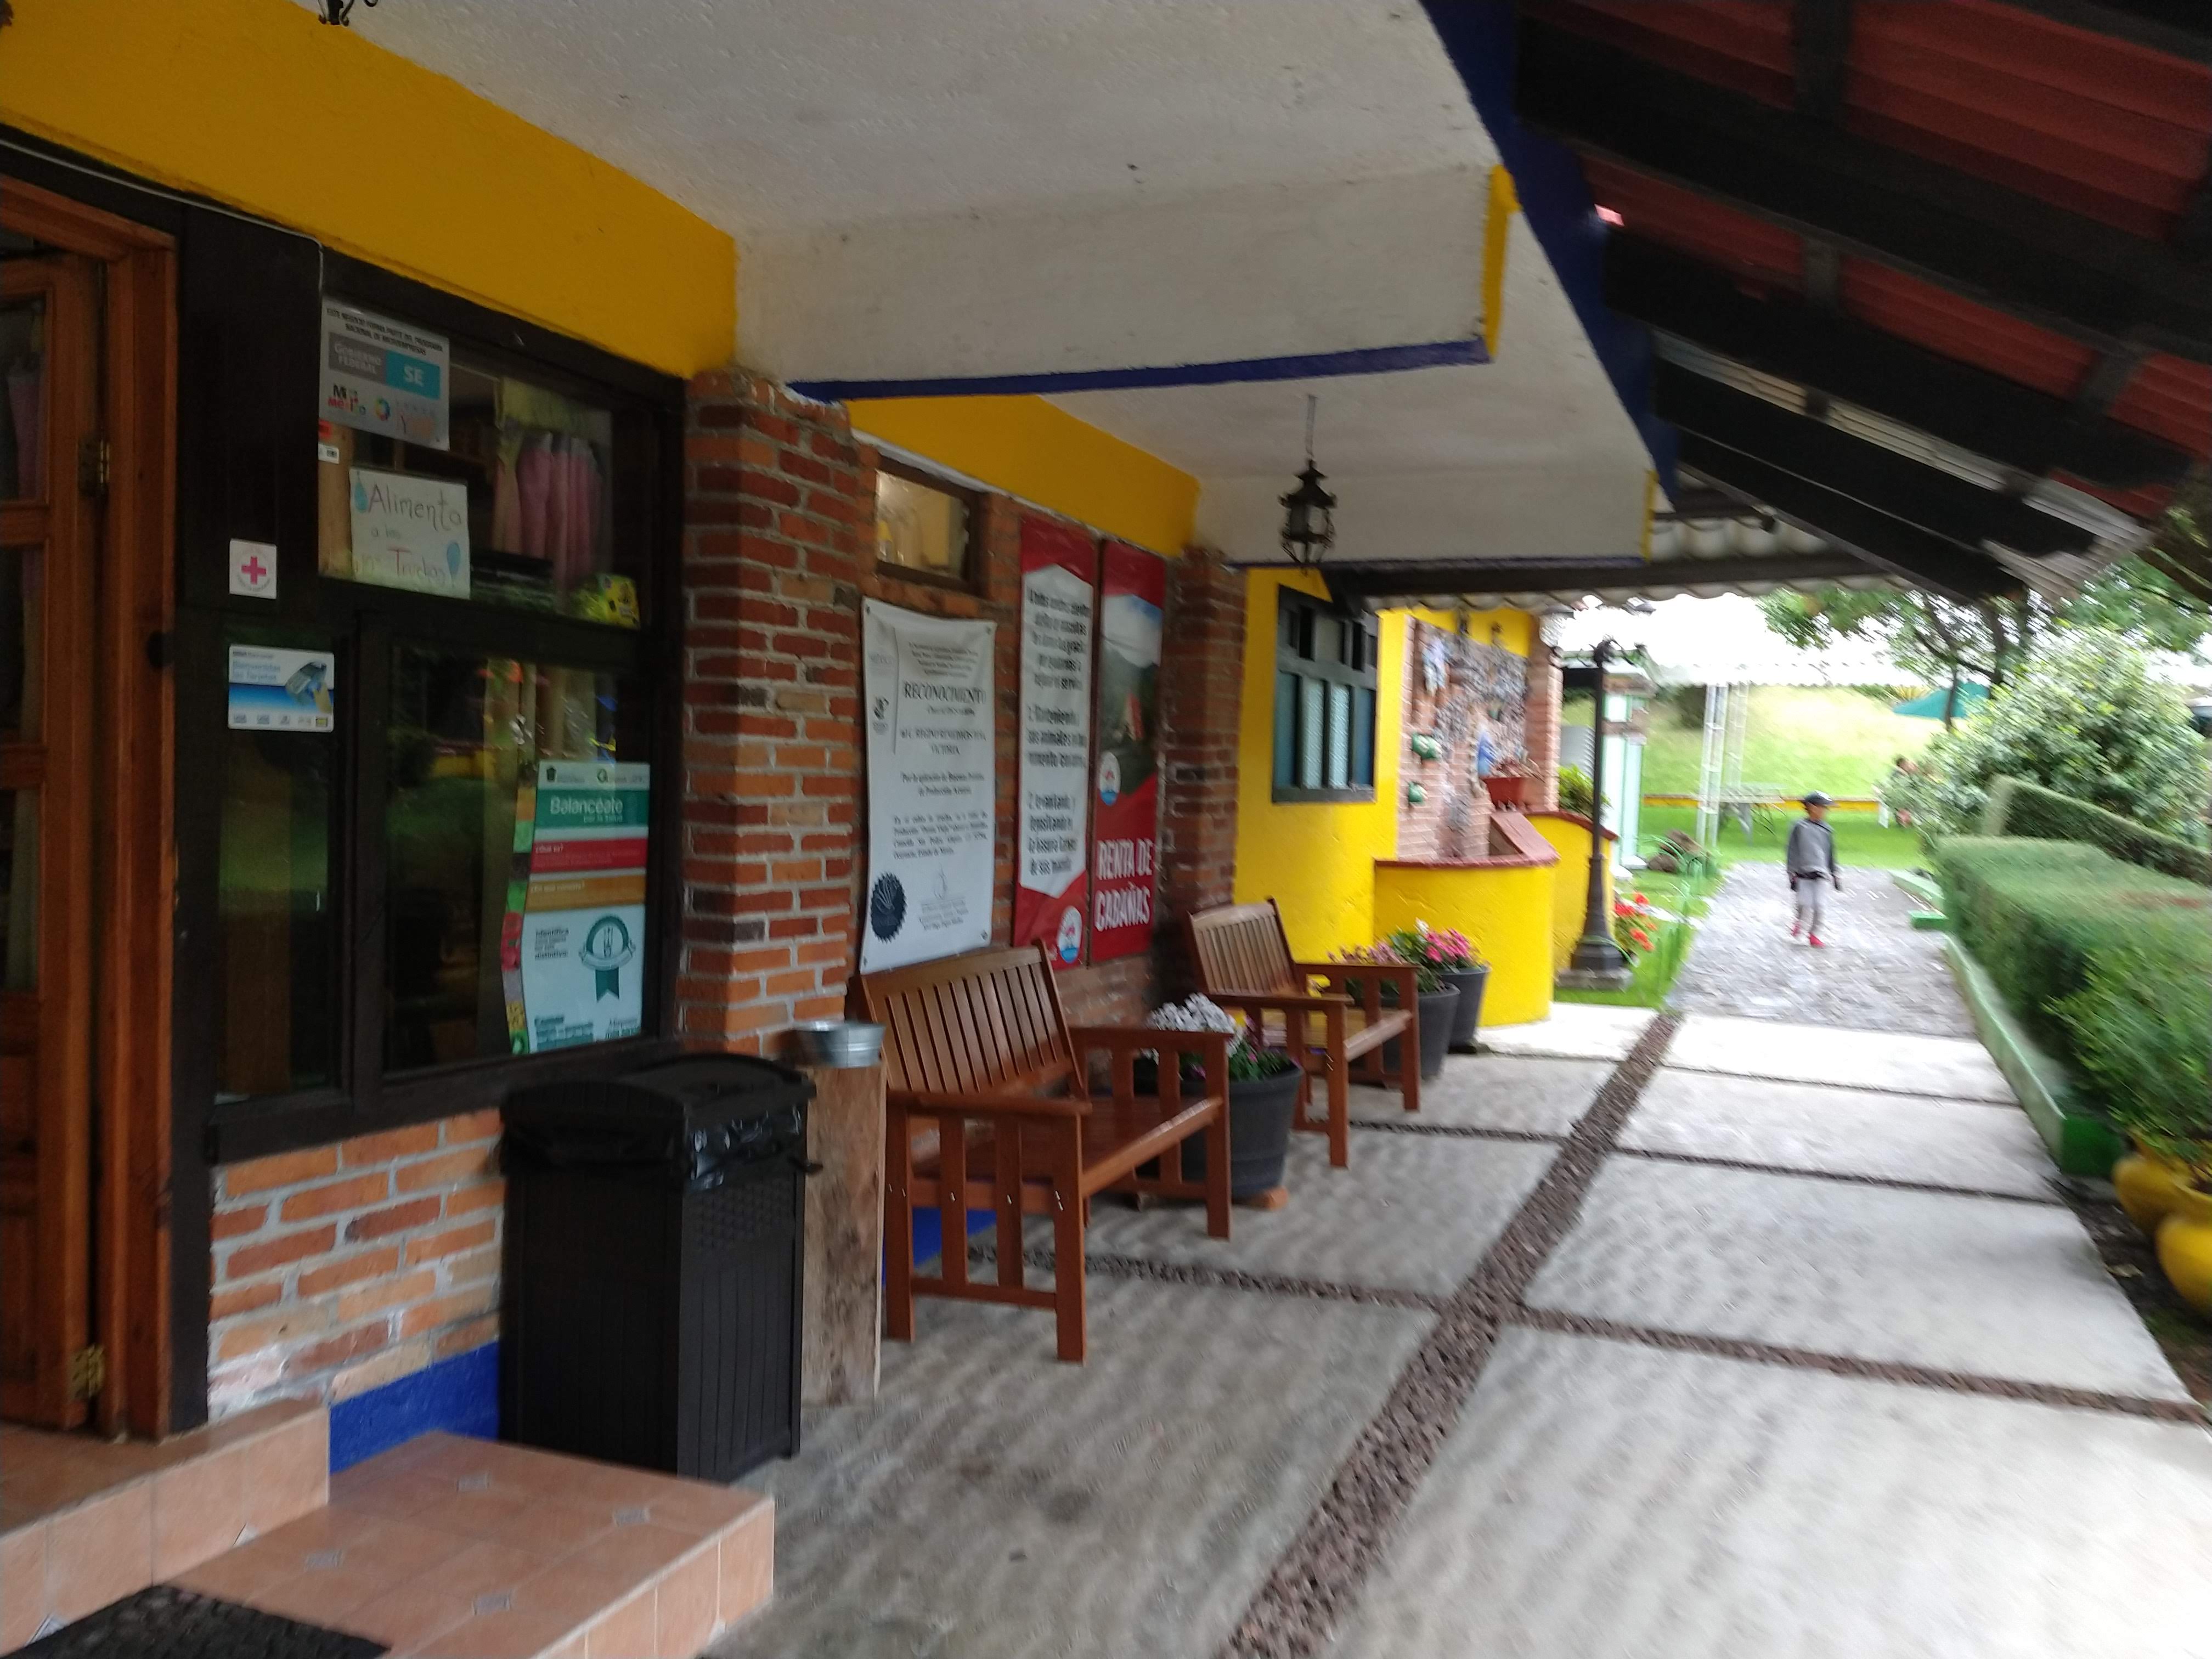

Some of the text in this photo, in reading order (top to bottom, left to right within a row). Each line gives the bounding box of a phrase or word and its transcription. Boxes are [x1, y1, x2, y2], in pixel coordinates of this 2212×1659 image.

[403, 365, 425, 387] SE
[368, 483, 462, 532] Alimento
[1097, 839, 1135, 881] RENTA
[1136, 837, 1153, 876] DE
[1095, 881, 1150, 933] CABAÑAS
